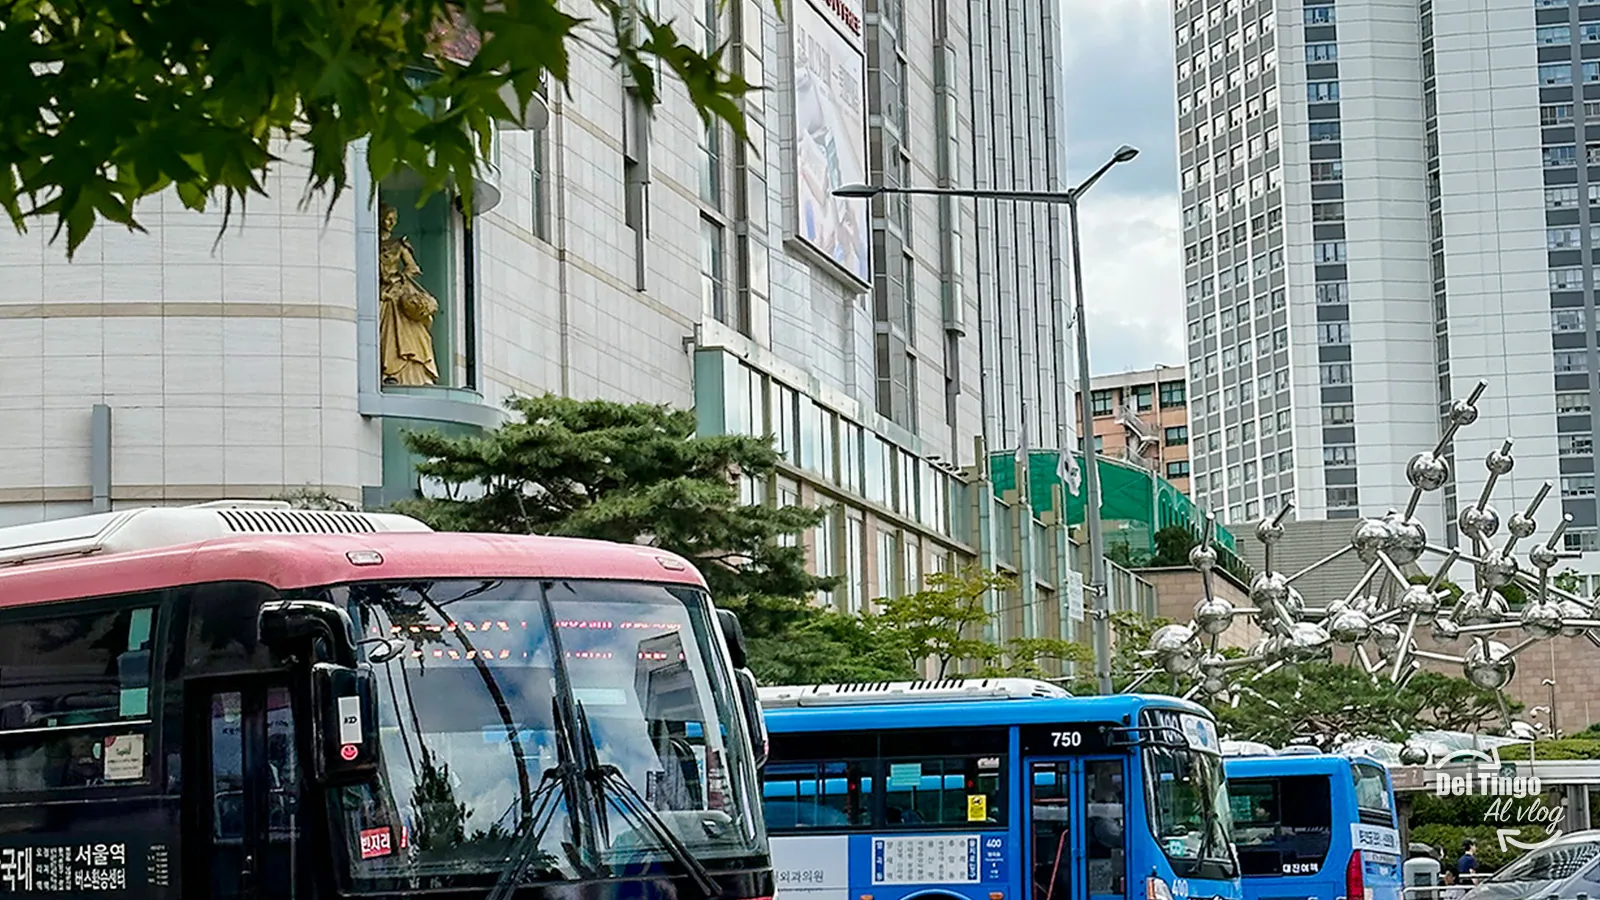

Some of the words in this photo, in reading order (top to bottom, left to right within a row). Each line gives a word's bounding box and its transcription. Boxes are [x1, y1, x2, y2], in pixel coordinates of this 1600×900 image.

[1051, 731, 1082, 747] 750
[361, 833, 391, 852] 빈자리
[986, 838, 1002, 848] 400
[75, 843, 126, 866] 서울역
[0, 847, 33, 892] 국대
[75, 867, 126, 890] 버스환승센터
[1171, 879, 1189, 897] 400
